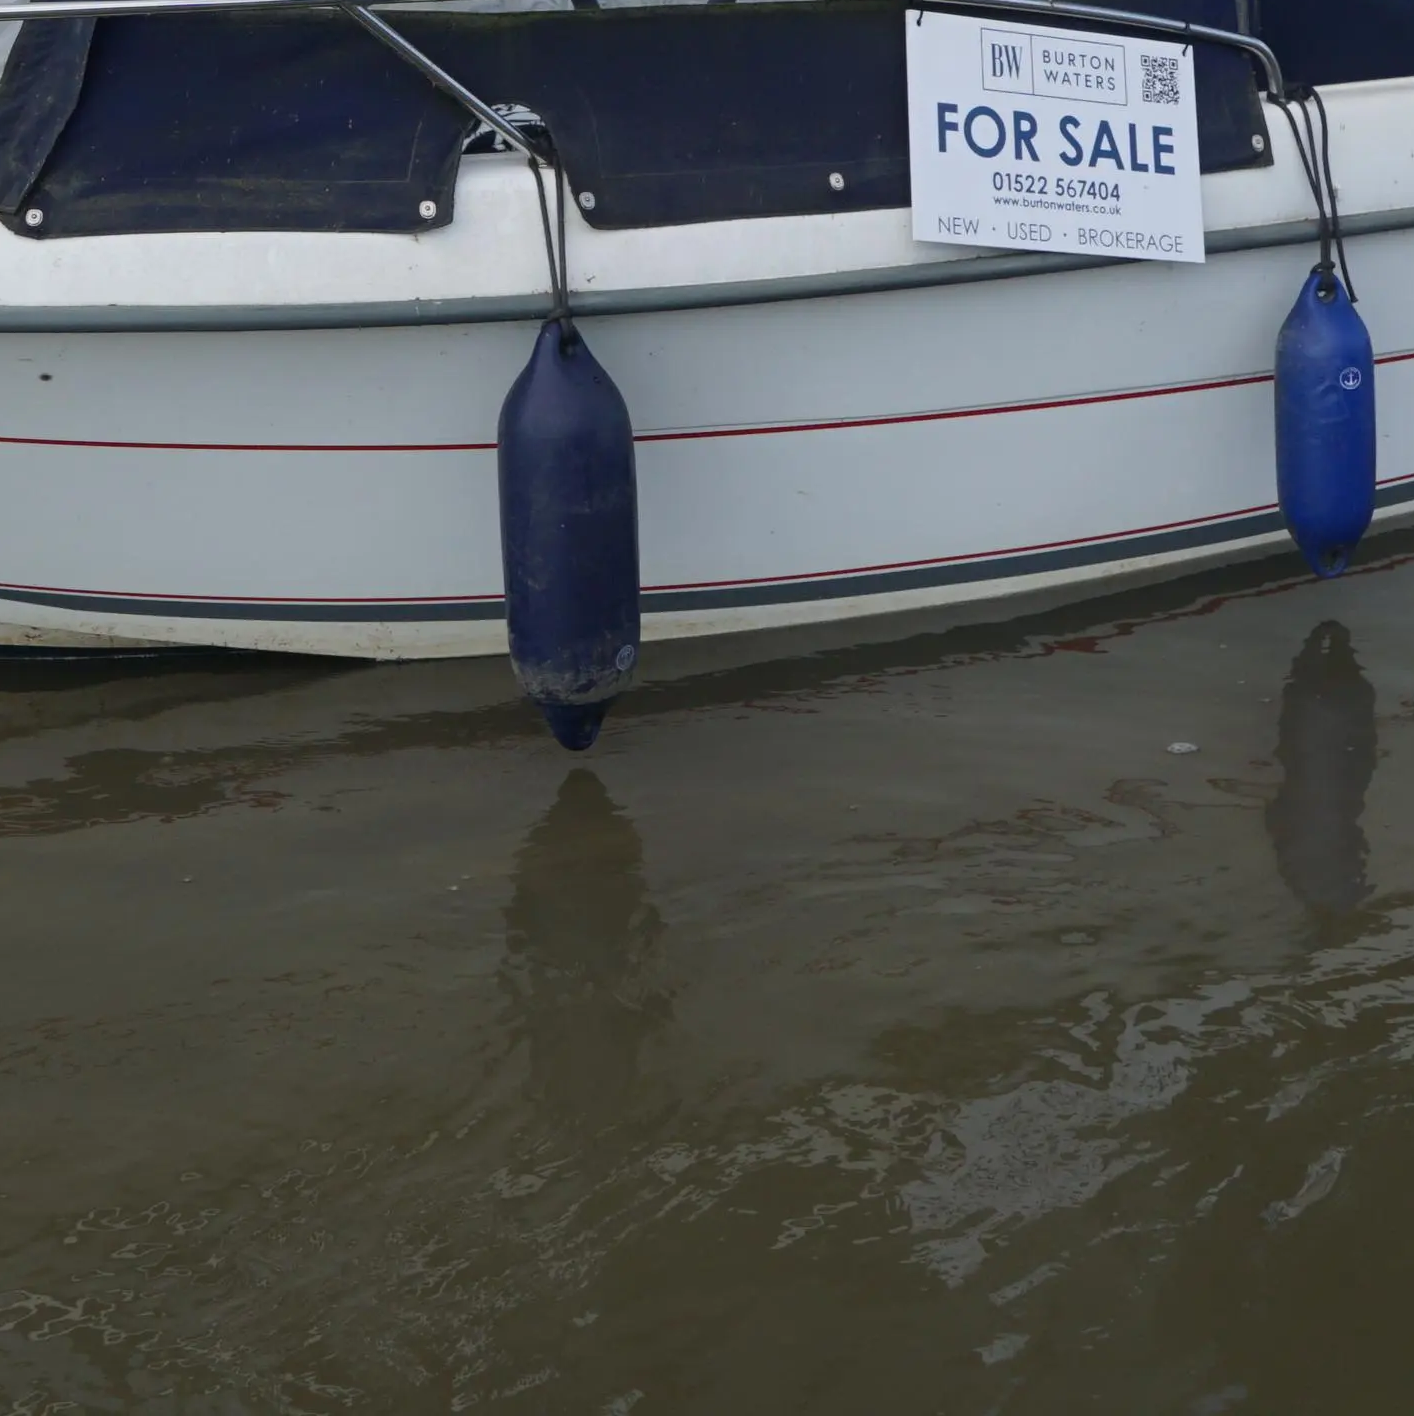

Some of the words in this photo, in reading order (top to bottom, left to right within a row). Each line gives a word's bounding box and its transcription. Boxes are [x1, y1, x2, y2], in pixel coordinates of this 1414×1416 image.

[990, 42, 1023, 80] BW
[1042, 49, 1116, 72] BURTON
[1044, 69, 1116, 92] WATERS
[937, 101, 1041, 163] FOR
[1059, 114, 1176, 176] SALE
[992, 171, 1048, 196] 01522
[1054, 177, 1121, 203] 567404
[992, 195, 1122, 216] www.burtonwaters.co.uk
[937, 216, 980, 236] NEW
[1007, 222, 1052, 242] USED
[1077, 228, 1184, 254] BROKERAGE
